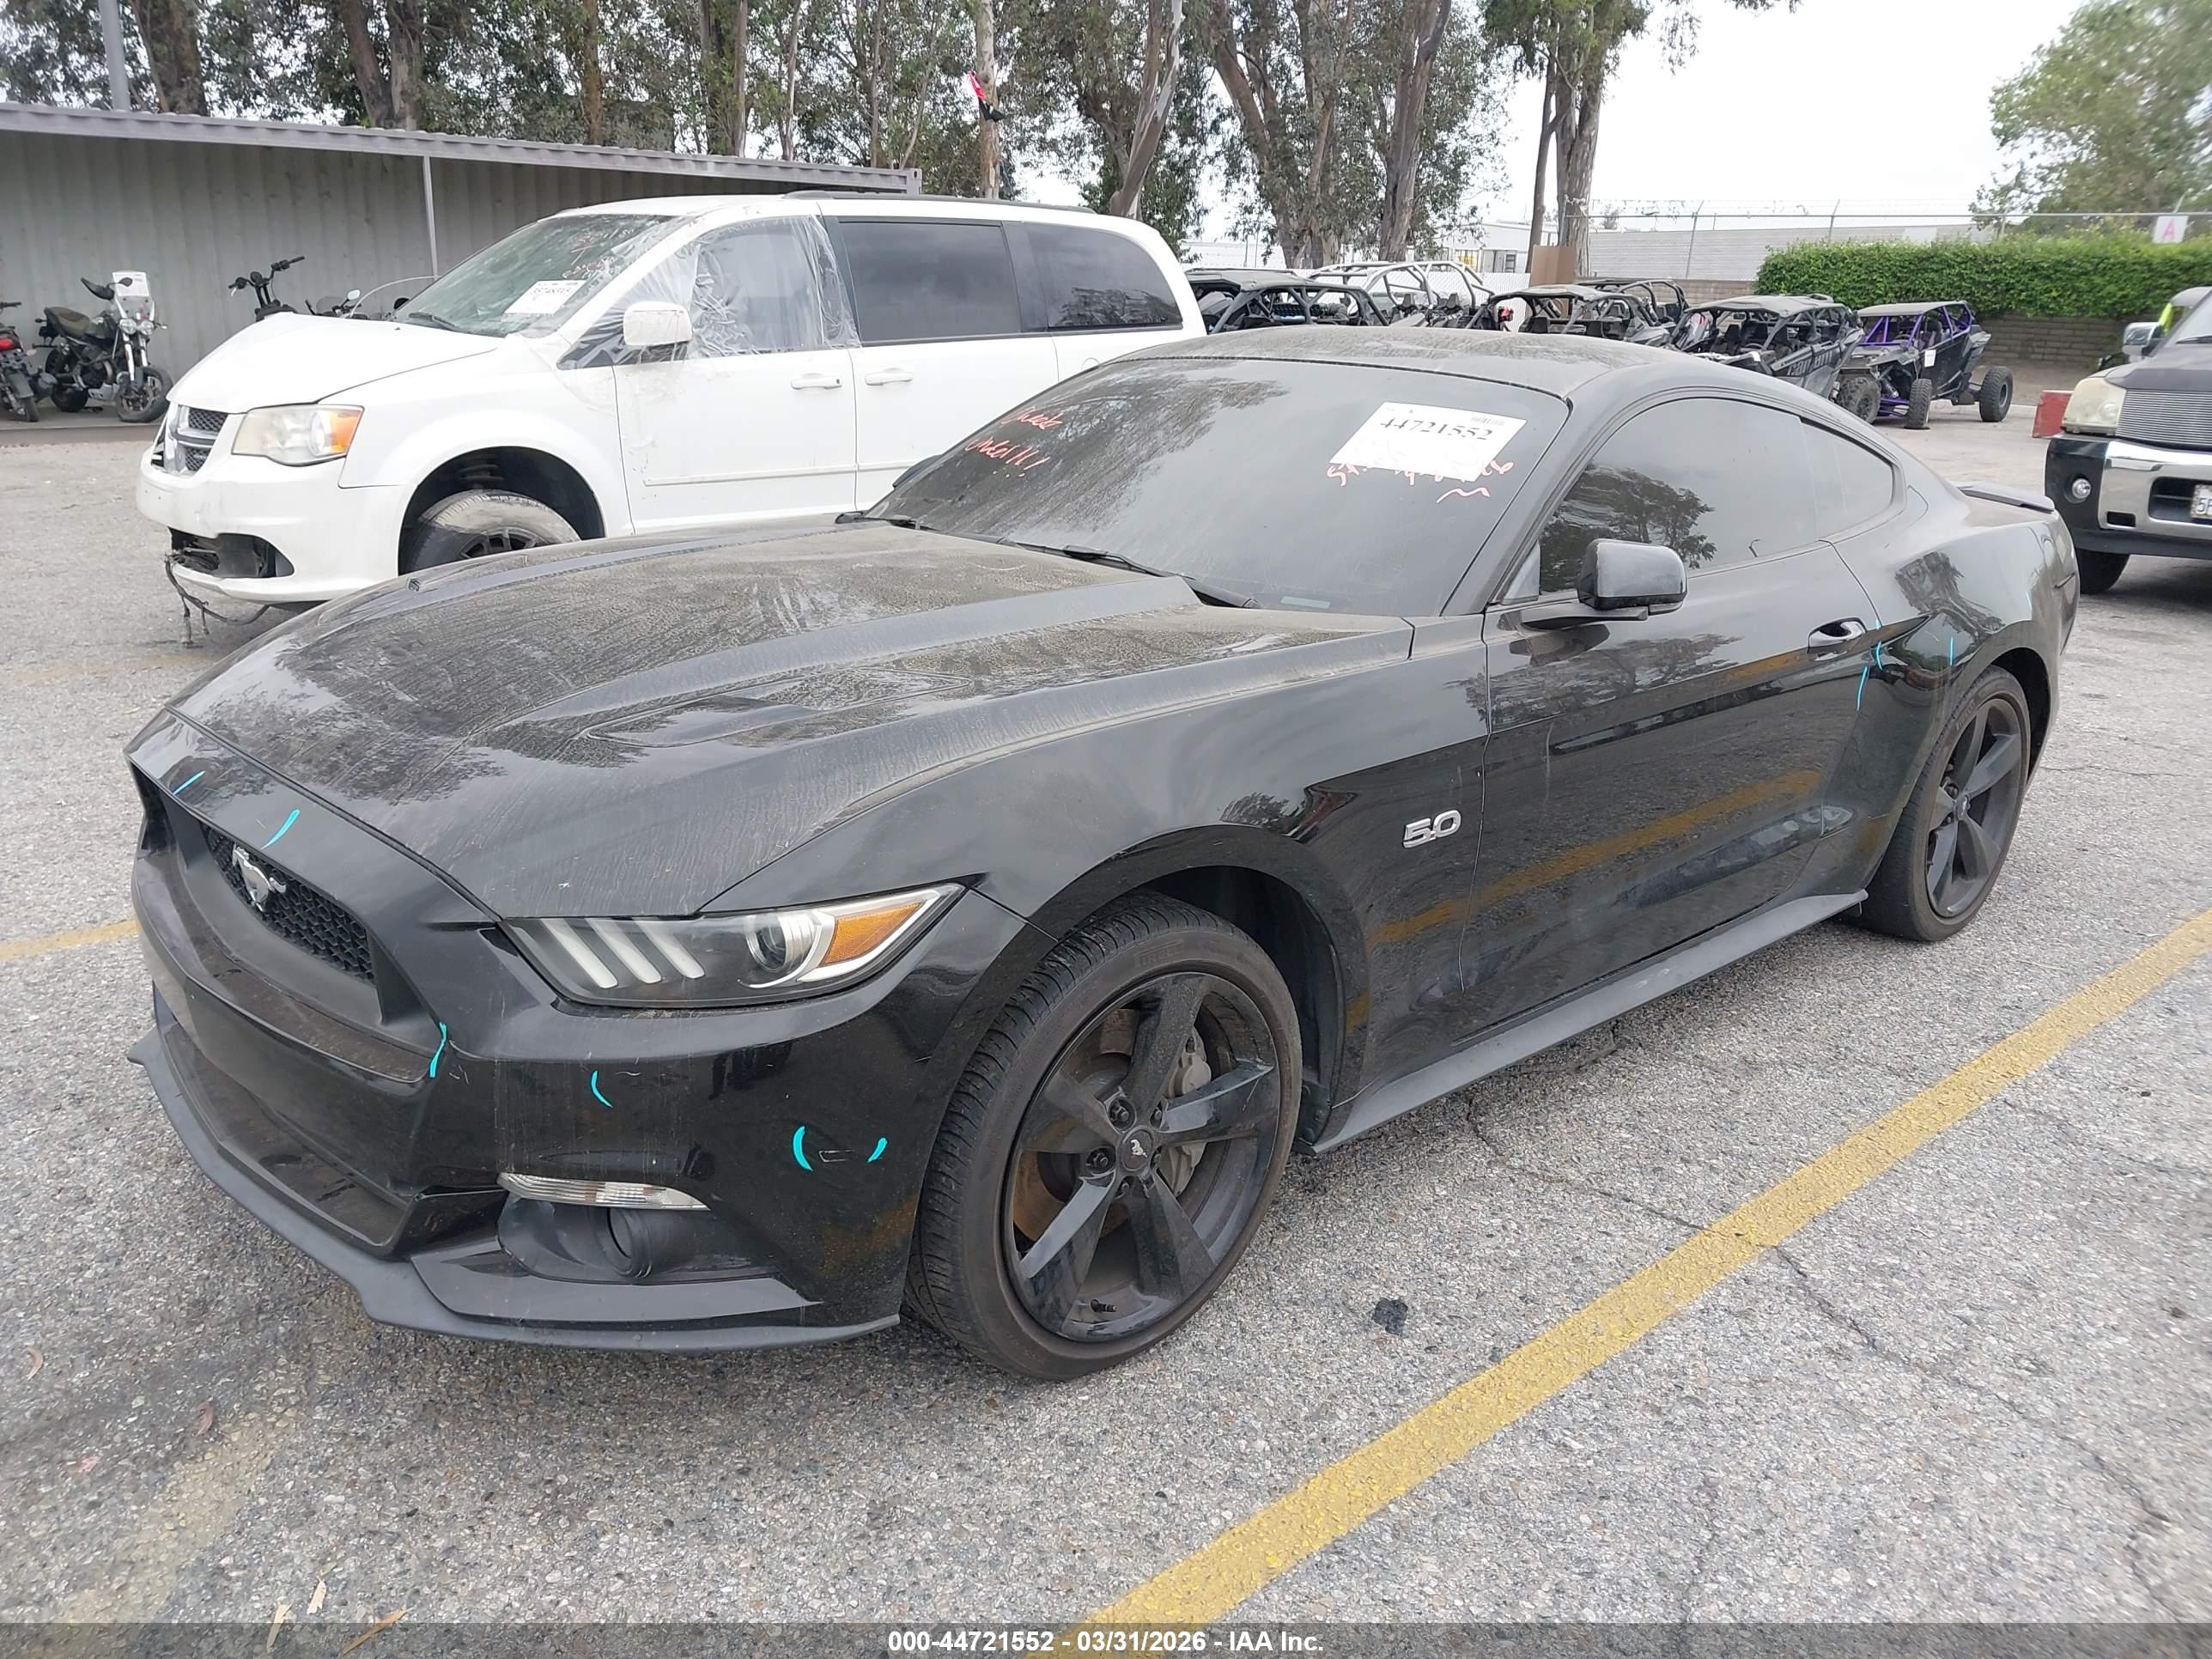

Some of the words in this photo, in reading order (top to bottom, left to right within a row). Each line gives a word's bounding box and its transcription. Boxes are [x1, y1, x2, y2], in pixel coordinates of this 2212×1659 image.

[2161, 217, 2176, 241] A
[1380, 417, 1493, 441] 44721552
[1402, 810, 1462, 848] 5.0
